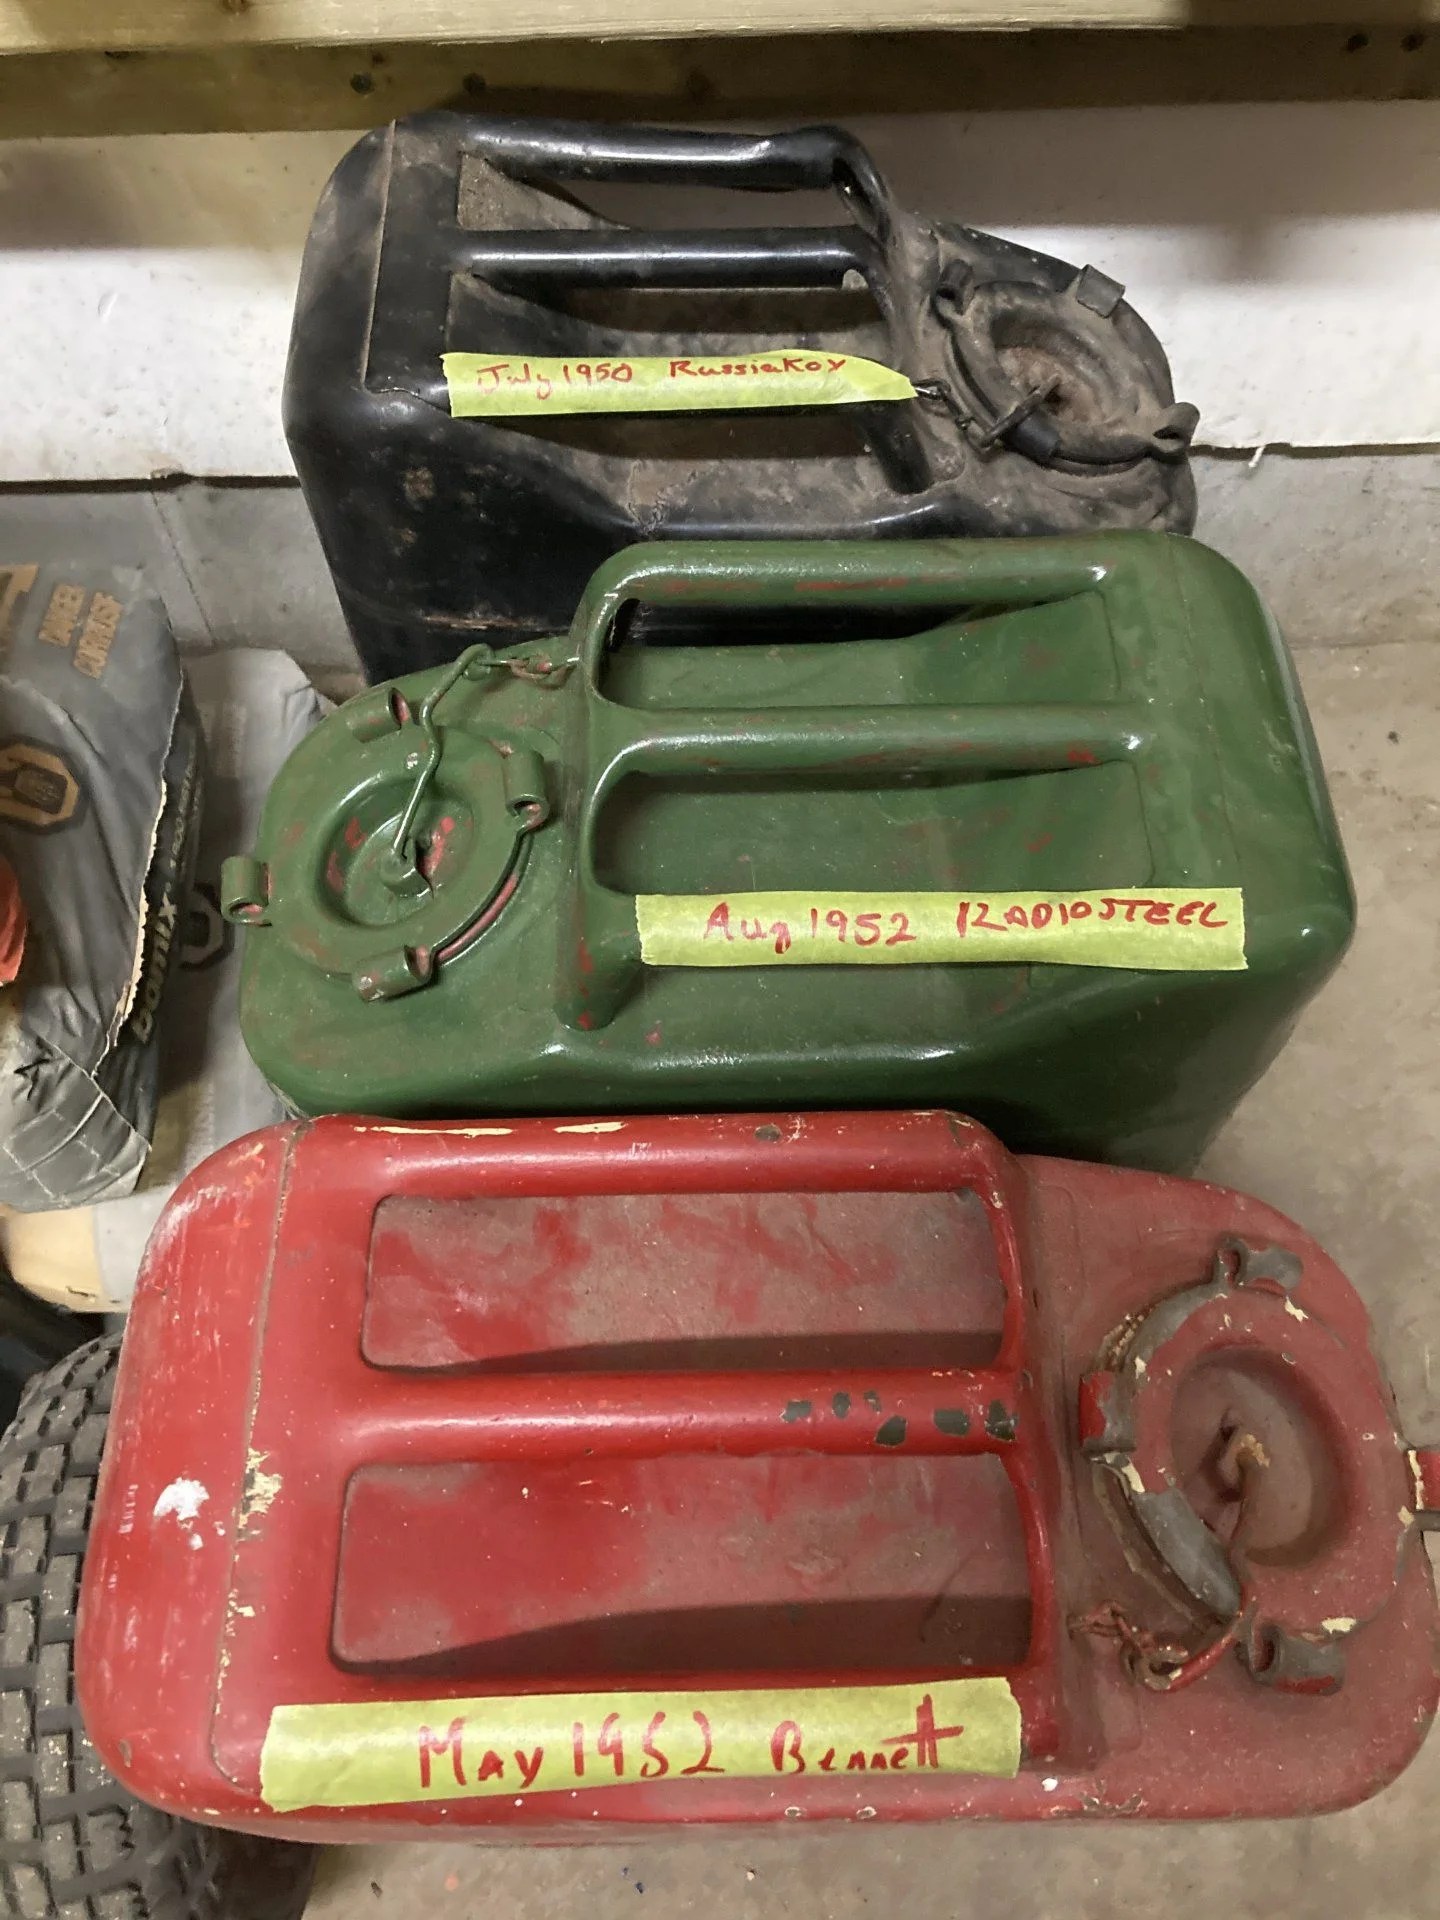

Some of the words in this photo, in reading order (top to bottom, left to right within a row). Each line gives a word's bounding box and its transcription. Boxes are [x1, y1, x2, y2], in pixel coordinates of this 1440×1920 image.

[476, 364, 552, 400] July
[563, 363, 634, 383] 1950
[702, 902, 791, 954] Aug
[810, 908, 917, 947] 1952
[418, 1715, 544, 1789] May
[573, 1711, 724, 1778] 1952
[771, 1694, 964, 1774] Bennett
